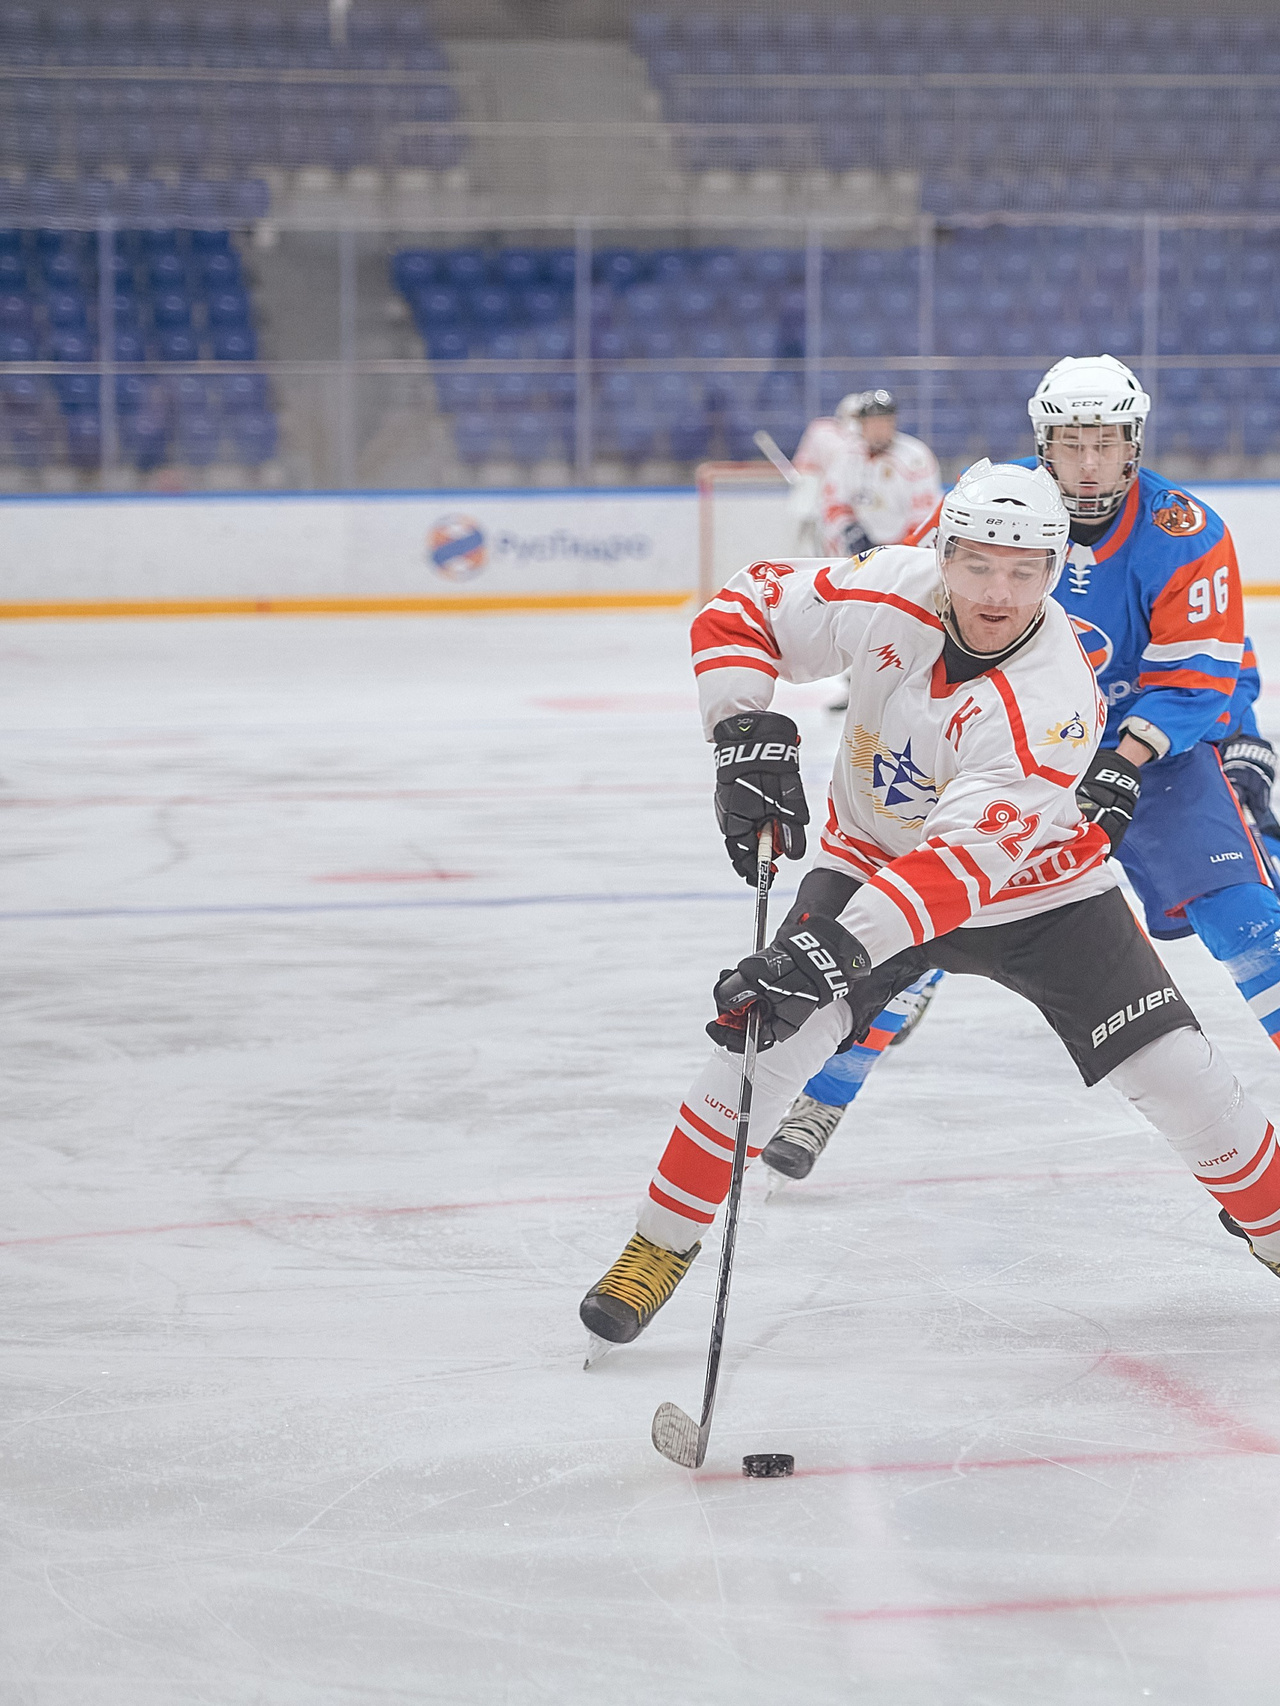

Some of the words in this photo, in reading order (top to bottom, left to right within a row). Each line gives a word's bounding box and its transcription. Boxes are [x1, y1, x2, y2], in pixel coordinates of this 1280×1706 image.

[1187, 565, 1229, 624] 96
[973, 799, 1042, 862] 92
[1210, 851, 1244, 864] LUTCH
[788, 931, 849, 1001] BAUE
[1091, 987, 1179, 1049] BAUER
[1197, 1147, 1239, 1167] LUTCH
